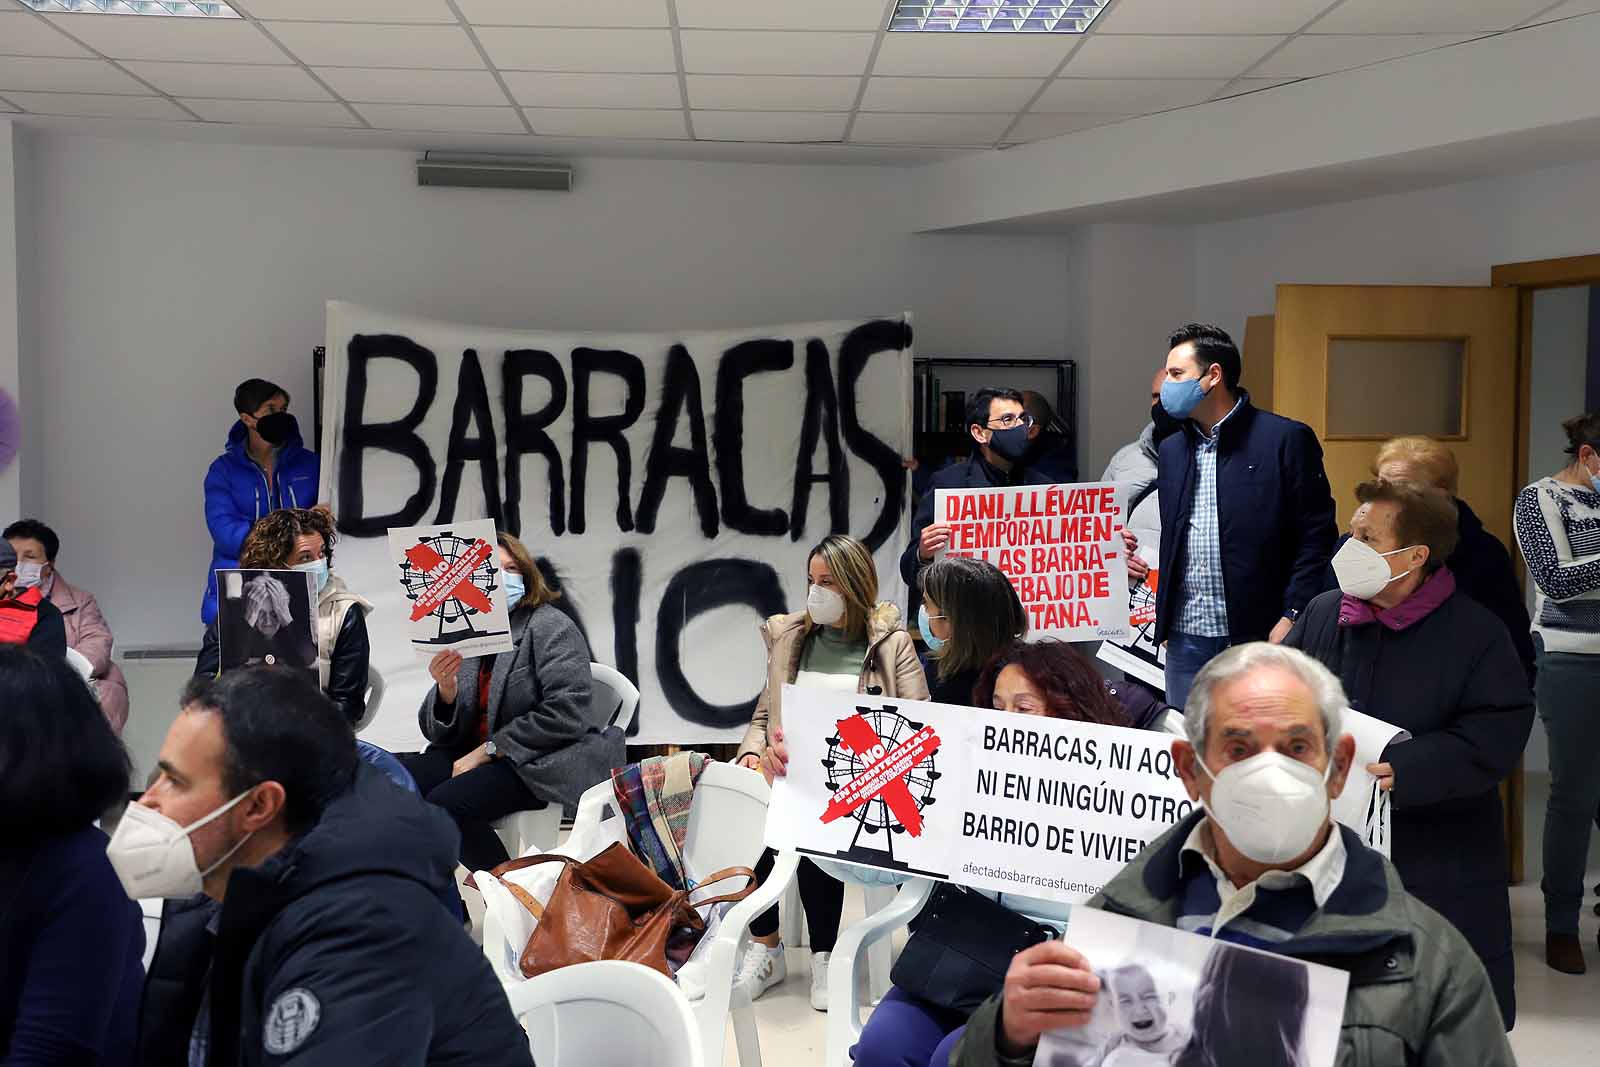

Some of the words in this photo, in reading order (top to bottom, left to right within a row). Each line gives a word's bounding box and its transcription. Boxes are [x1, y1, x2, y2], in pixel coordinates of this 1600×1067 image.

[337, 319, 913, 552] BARRACAS
[946, 493, 1011, 521] DANI,
[1014, 486, 1120, 518] LLÉVATE,
[949, 516, 1122, 550] TEMPORALMEN-
[429, 561, 449, 581] NO
[1031, 543, 1117, 573] BARRA-
[1078, 571, 1109, 598] DE
[833, 787, 849, 804] EN
[849, 730, 930, 790] FUENTECILLAS
[859, 744, 885, 769] NO
[983, 725, 1102, 770] BARRACAS,
[1109, 743, 1132, 770] NI
[1137, 747, 1181, 780] AQ
[977, 769, 998, 796] NI
[1003, 773, 1031, 801] EN
[1037, 778, 1124, 816] NINGÚN
[1131, 793, 1192, 824] OTRO
[963, 812, 1040, 847] BARRIO
[1046, 825, 1074, 854] DE
